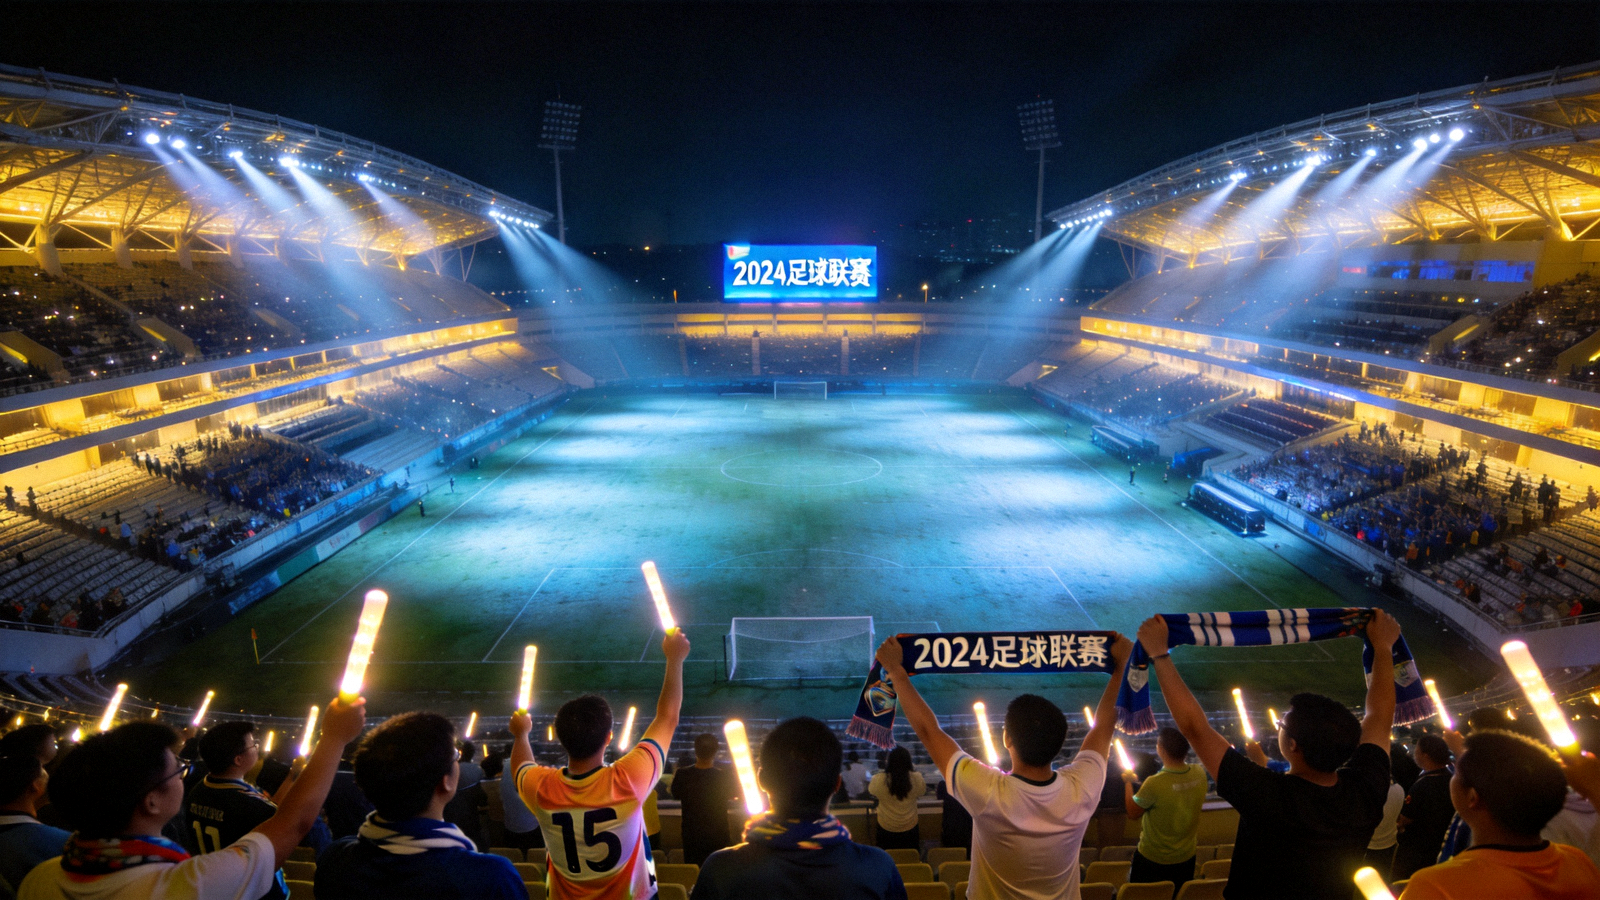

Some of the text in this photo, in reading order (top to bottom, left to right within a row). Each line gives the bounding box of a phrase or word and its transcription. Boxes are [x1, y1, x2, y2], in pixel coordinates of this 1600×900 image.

[733, 257, 872, 287] 2024足球联赛
[914, 634, 1108, 669] 2024足球联赛
[552, 807, 622, 873] 15
